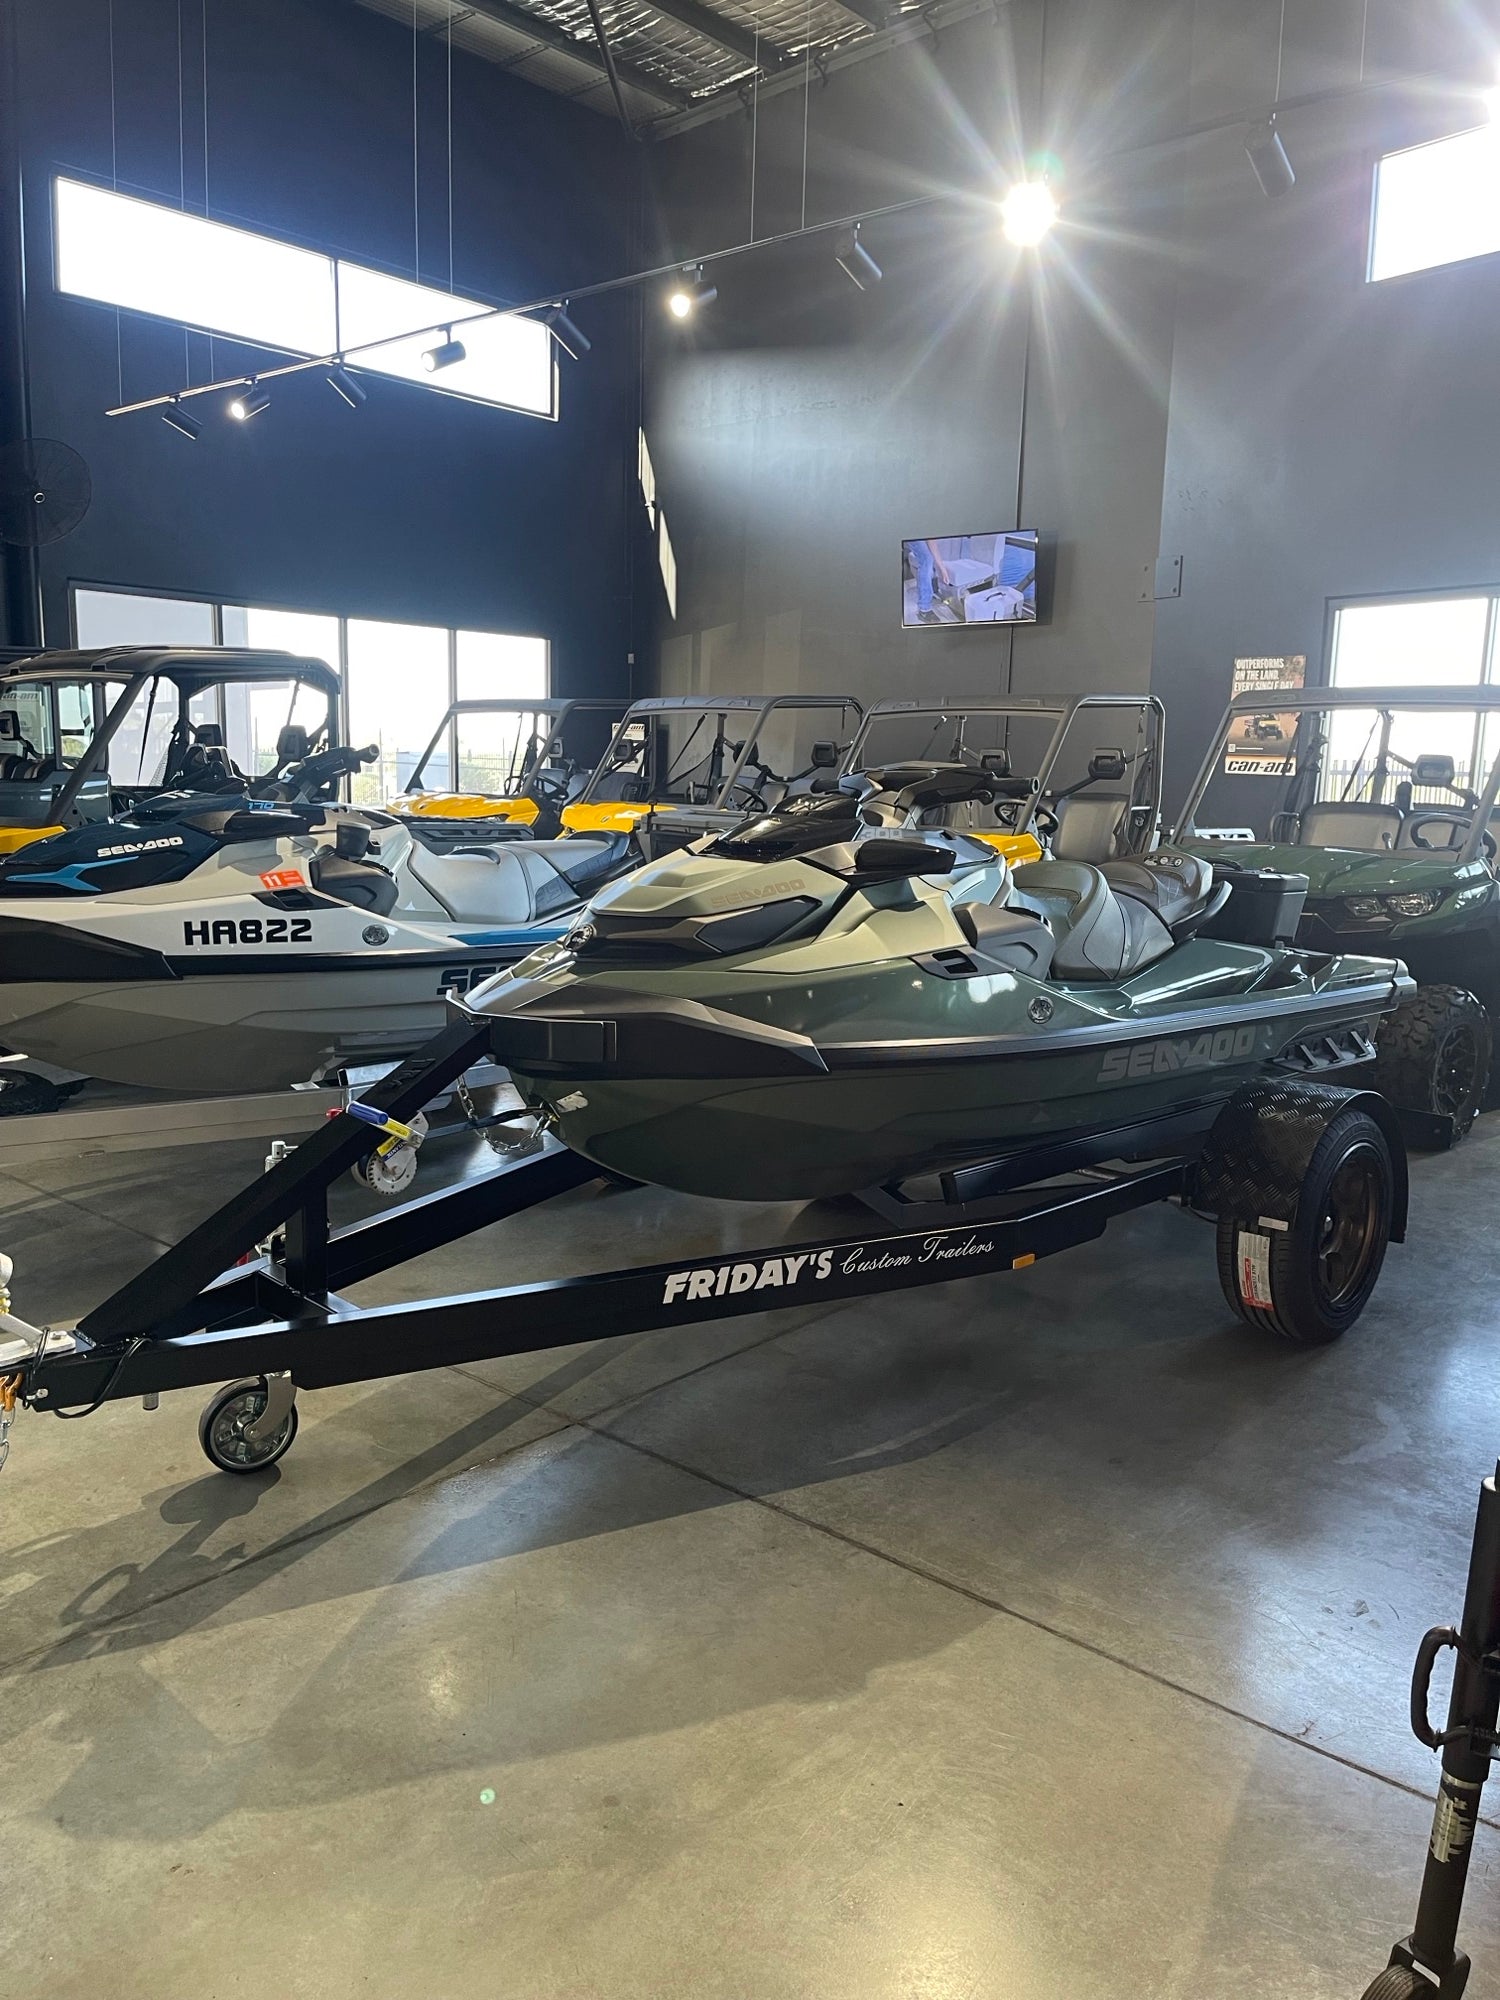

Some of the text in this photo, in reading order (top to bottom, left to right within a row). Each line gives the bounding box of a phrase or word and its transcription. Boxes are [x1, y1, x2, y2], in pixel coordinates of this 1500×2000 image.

[1236, 658, 1285, 669] OUTPERFORMS
[1235, 670, 1245, 680] ON
[1247, 670, 1259, 680] THE
[1234, 681, 1256, 691] EVERY
[263, 874, 282, 887] 11
[184, 918, 312, 945] HA822
[663, 1235, 996, 1304] FRIDAY'S Custom Trailers
